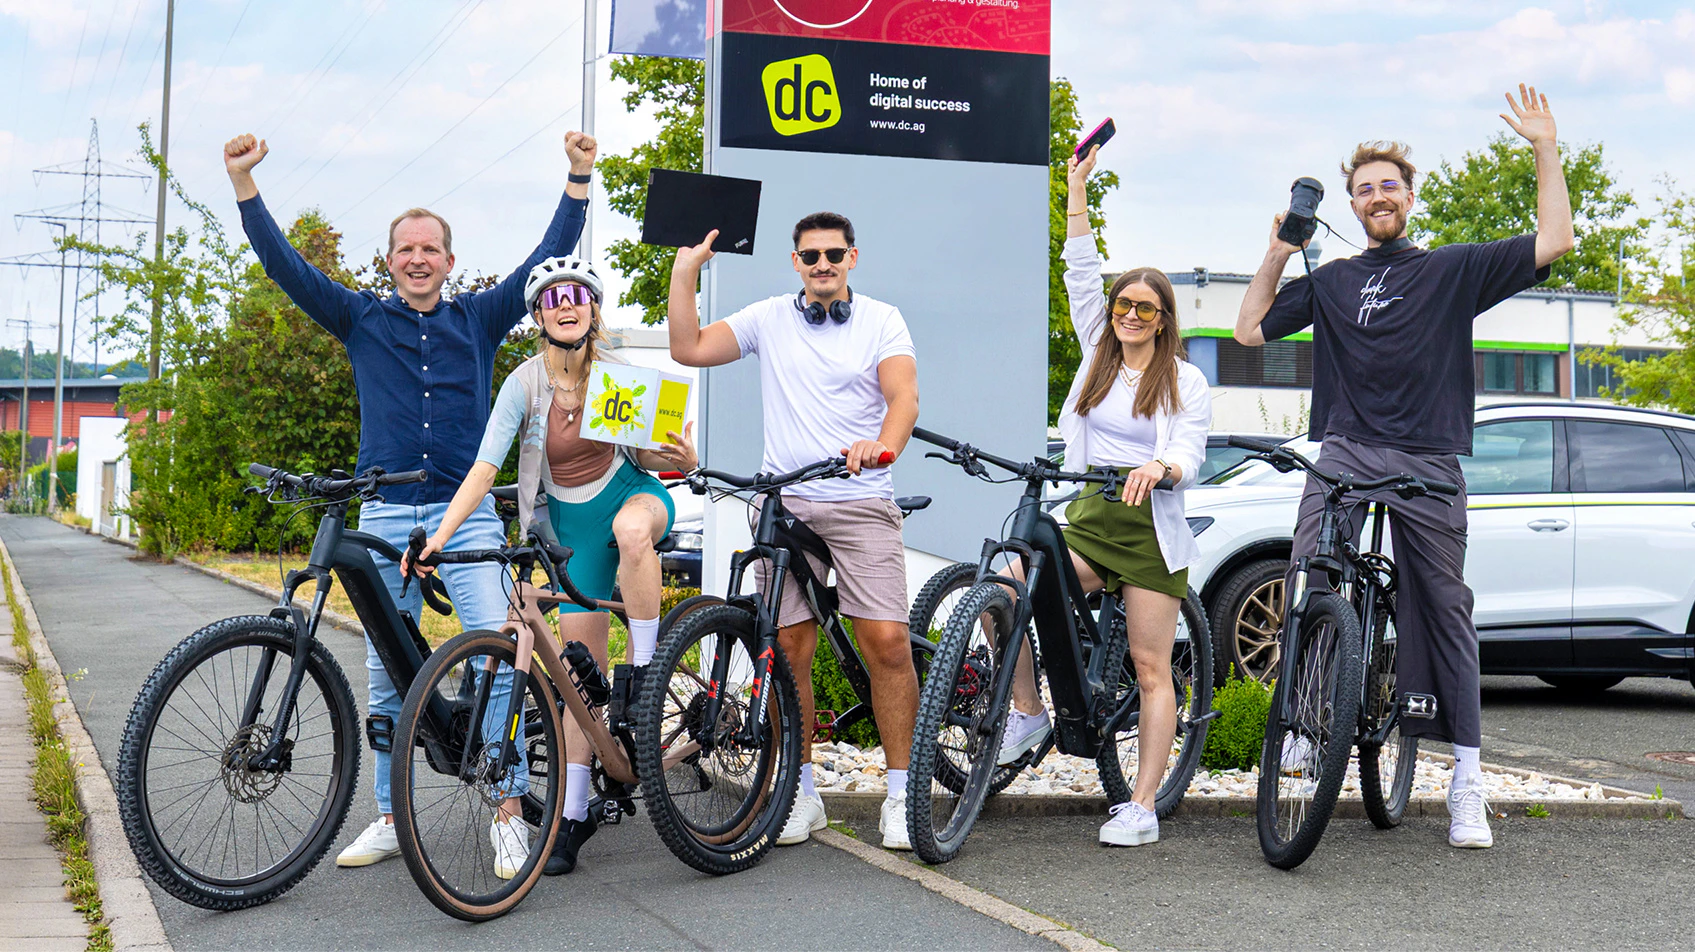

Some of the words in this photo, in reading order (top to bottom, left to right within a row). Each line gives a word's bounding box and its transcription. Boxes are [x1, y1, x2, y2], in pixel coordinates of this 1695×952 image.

[774, 63, 832, 123] dc
[870, 73, 909, 89] Home
[912, 76, 927, 90] of
[869, 93, 912, 110] digital
[914, 99, 971, 112] success
[870, 119, 925, 133] www.dc.ag
[604, 391, 632, 422] dc
[658, 408, 683, 420] www.dc.ag
[730, 834, 769, 862] MAXXIS
[173, 866, 245, 896] SCHWALBE
